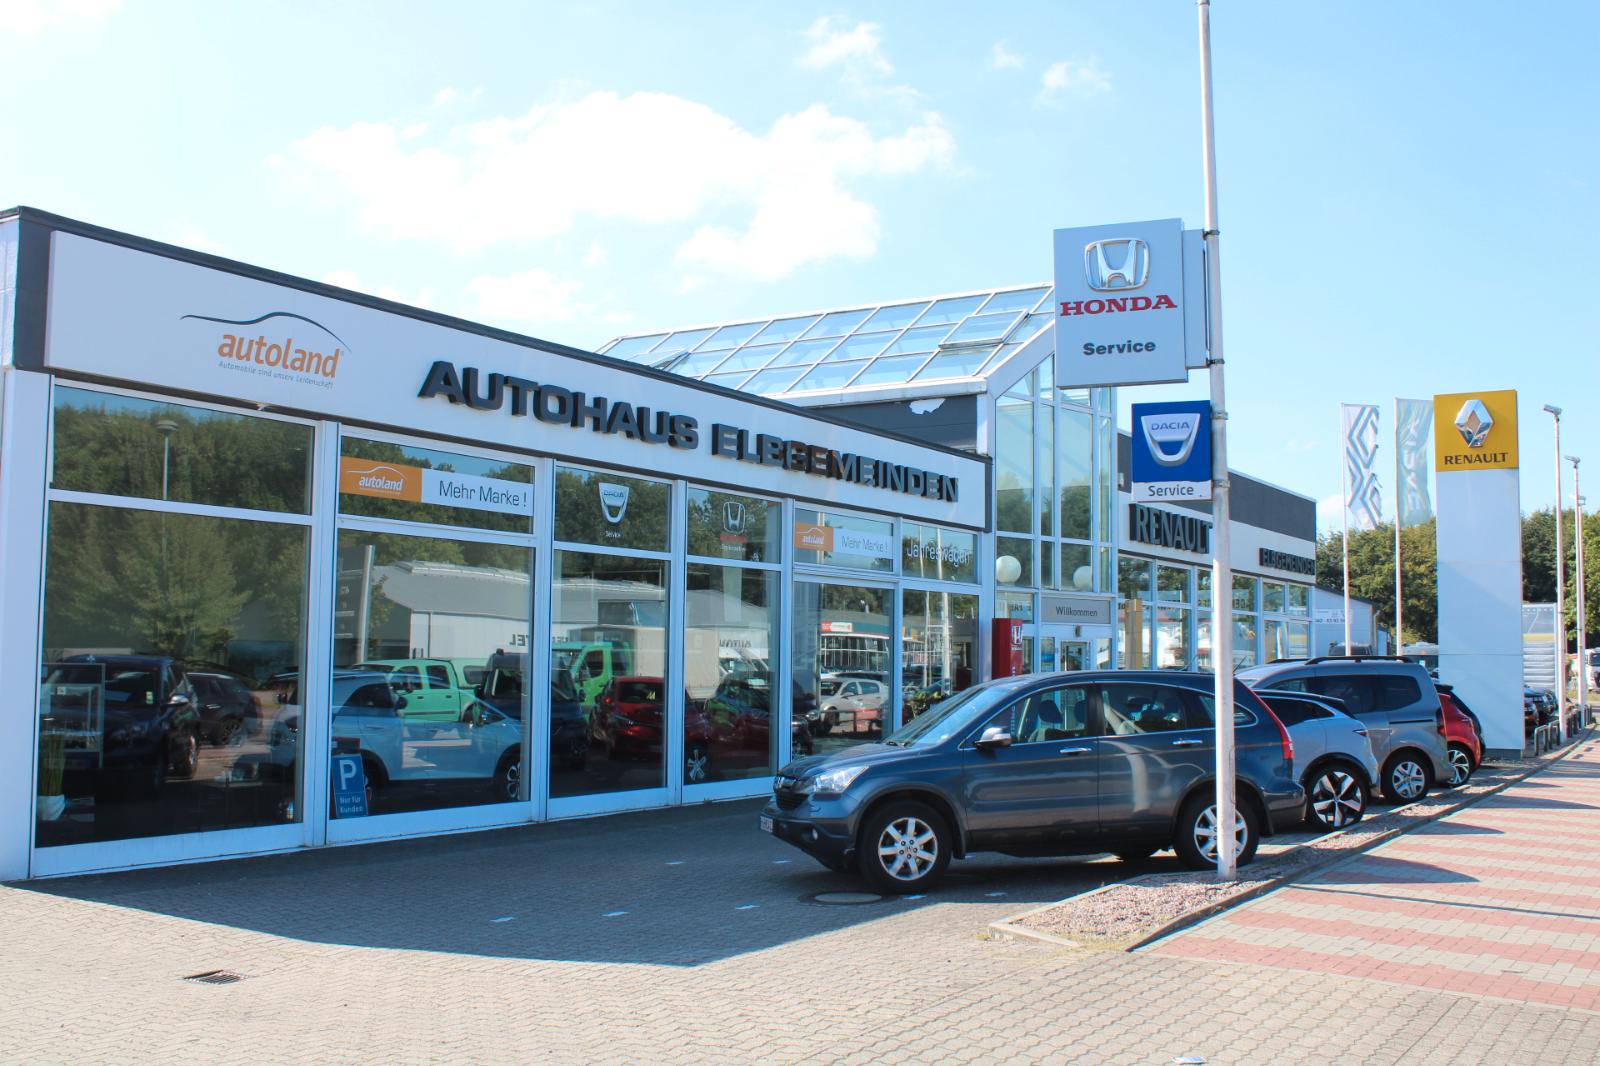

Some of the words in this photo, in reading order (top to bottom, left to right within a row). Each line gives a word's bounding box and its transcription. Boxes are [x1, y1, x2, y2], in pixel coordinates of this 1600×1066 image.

[1060, 295, 1177, 316] HONDA
[1083, 340, 1156, 355] Service
[218, 334, 340, 379] autoland
[418, 360, 698, 450] AUTOHAUS
[712, 423, 959, 502] ELBGEMEINDEN
[1151, 421, 1190, 430] DACIA
[1444, 452, 1508, 465] RENAULT
[358, 474, 404, 491] autoland
[1148, 484, 1194, 497] Service
[439, 480, 476, 500] Mehr
[479, 485, 520, 506] Marke
[1129, 504, 1213, 554] RENAULT
[841, 535, 860, 550] Mehr
[862, 538, 884, 552] Marke
[1056, 606, 1097, 617] Willkommen
[339, 759, 356, 790] P
